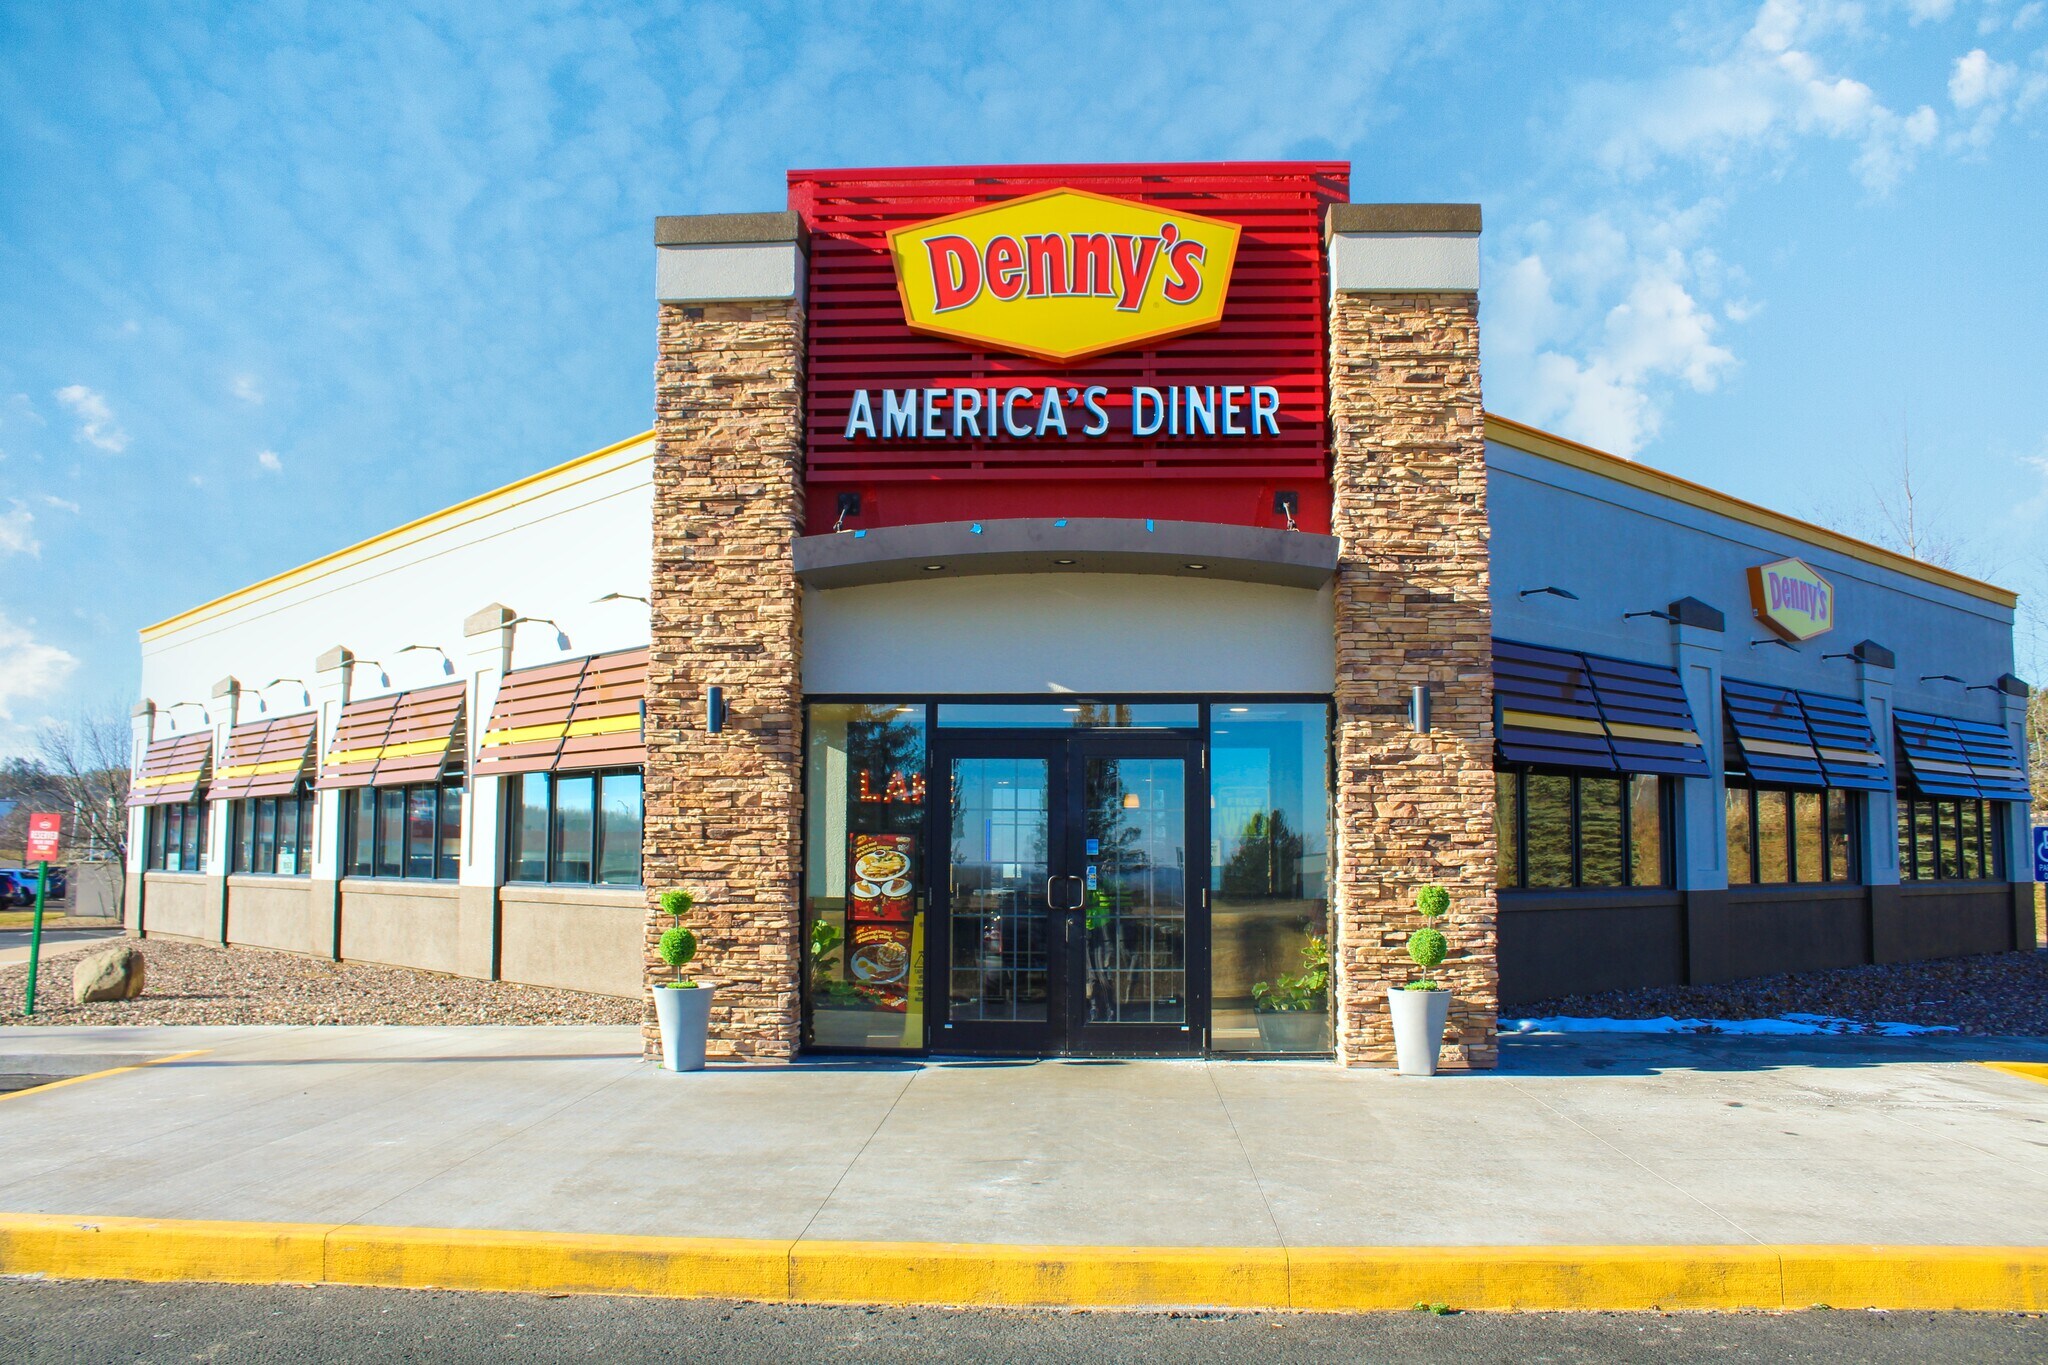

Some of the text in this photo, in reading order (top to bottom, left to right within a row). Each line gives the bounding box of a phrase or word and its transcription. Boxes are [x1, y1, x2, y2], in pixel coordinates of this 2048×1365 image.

[921, 222, 1206, 313] Denny's
[844, 385, 1281, 438] AMERICA'S DINER
[1768, 572, 1827, 621] Denny's
